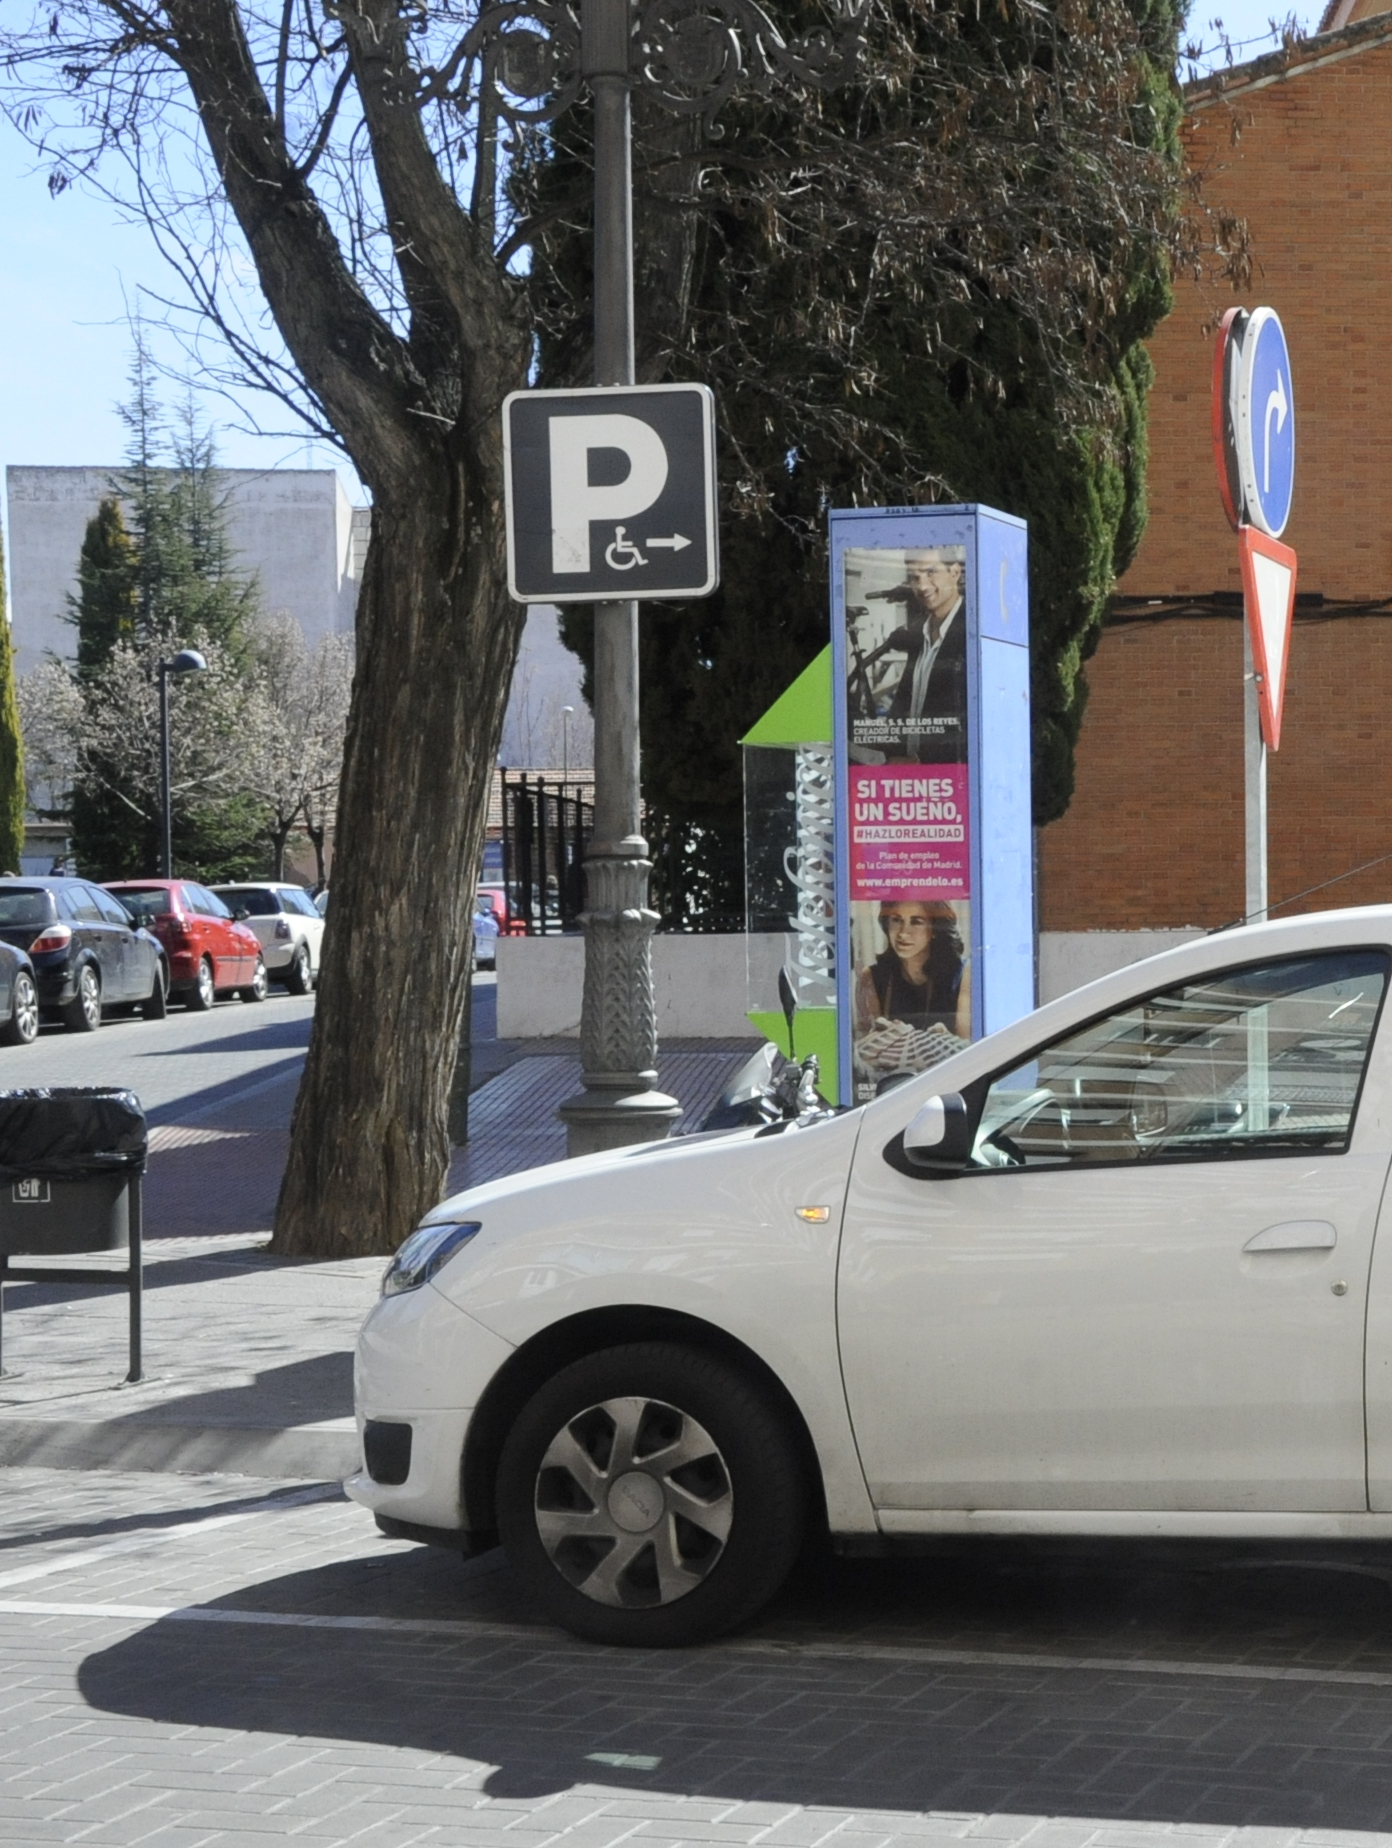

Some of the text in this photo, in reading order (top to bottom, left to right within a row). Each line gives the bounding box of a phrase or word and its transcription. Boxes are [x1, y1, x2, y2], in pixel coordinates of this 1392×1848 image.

[549, 414, 668, 573] P
[853, 718, 887, 727] MANUEL,
[905, 717, 916, 726] DE
[917, 717, 932, 725] LOS
[933, 716, 960, 726] REYES.
[853, 726, 946, 735] CREADOR DE BICICLETAS
[857, 778, 954, 798] SI TIENES
[854, 797, 962, 823] UN SUEÑO,
[856, 828, 962, 839] #HAZLOREALIDAD
[879, 851, 940, 861] Plan de empleo
[856, 860, 962, 870] de la Comunidad de Madrid.
[856, 876, 964, 888] www.emprendelo.es
